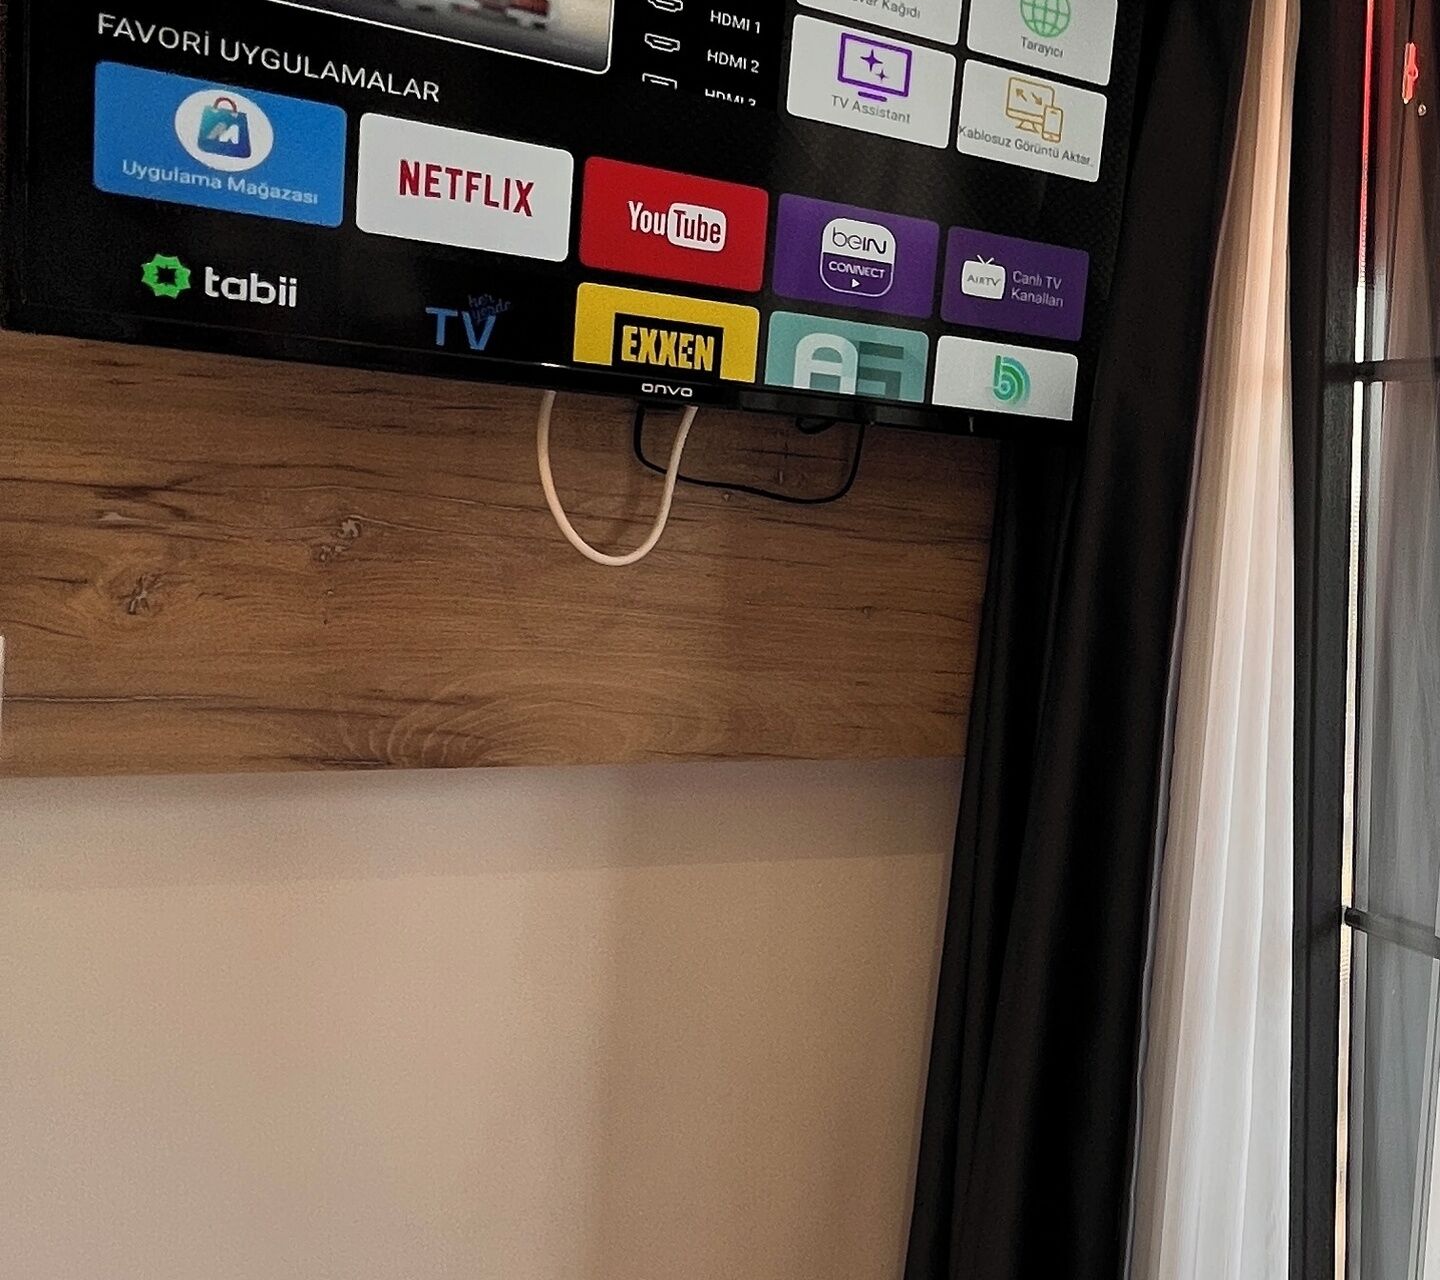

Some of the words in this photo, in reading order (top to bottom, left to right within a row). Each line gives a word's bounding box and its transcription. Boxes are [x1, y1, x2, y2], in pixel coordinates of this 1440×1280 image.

[709, 9, 750, 32] HDMI
[755, 21, 762, 35] 1
[97, 12, 210, 56] FAVORİ
[220, 37, 440, 103] UYGULAMALAR
[707, 48, 747, 71] HDMI
[750, 59, 761, 74] 2
[1020, 35, 1064, 59] Tarayıcı
[831, 94, 849, 109] TV
[852, 100, 911, 125] Assistant
[958, 125, 1012, 150] Kablosuz
[1014, 138, 1060, 158] Görüntü
[121, 158, 223, 190] Uygulama
[227, 176, 318, 205] Mağazası
[398, 159, 535, 218] NETFLIX
[627, 200, 723, 245] YouTube
[828, 260, 886, 280] CONNECT
[1045, 275, 1063, 290] TV
[204, 266, 297, 308] tabii
[425, 306, 497, 352] TV
[620, 324, 715, 372] EXXEN
[641, 382, 693, 398] onvo
